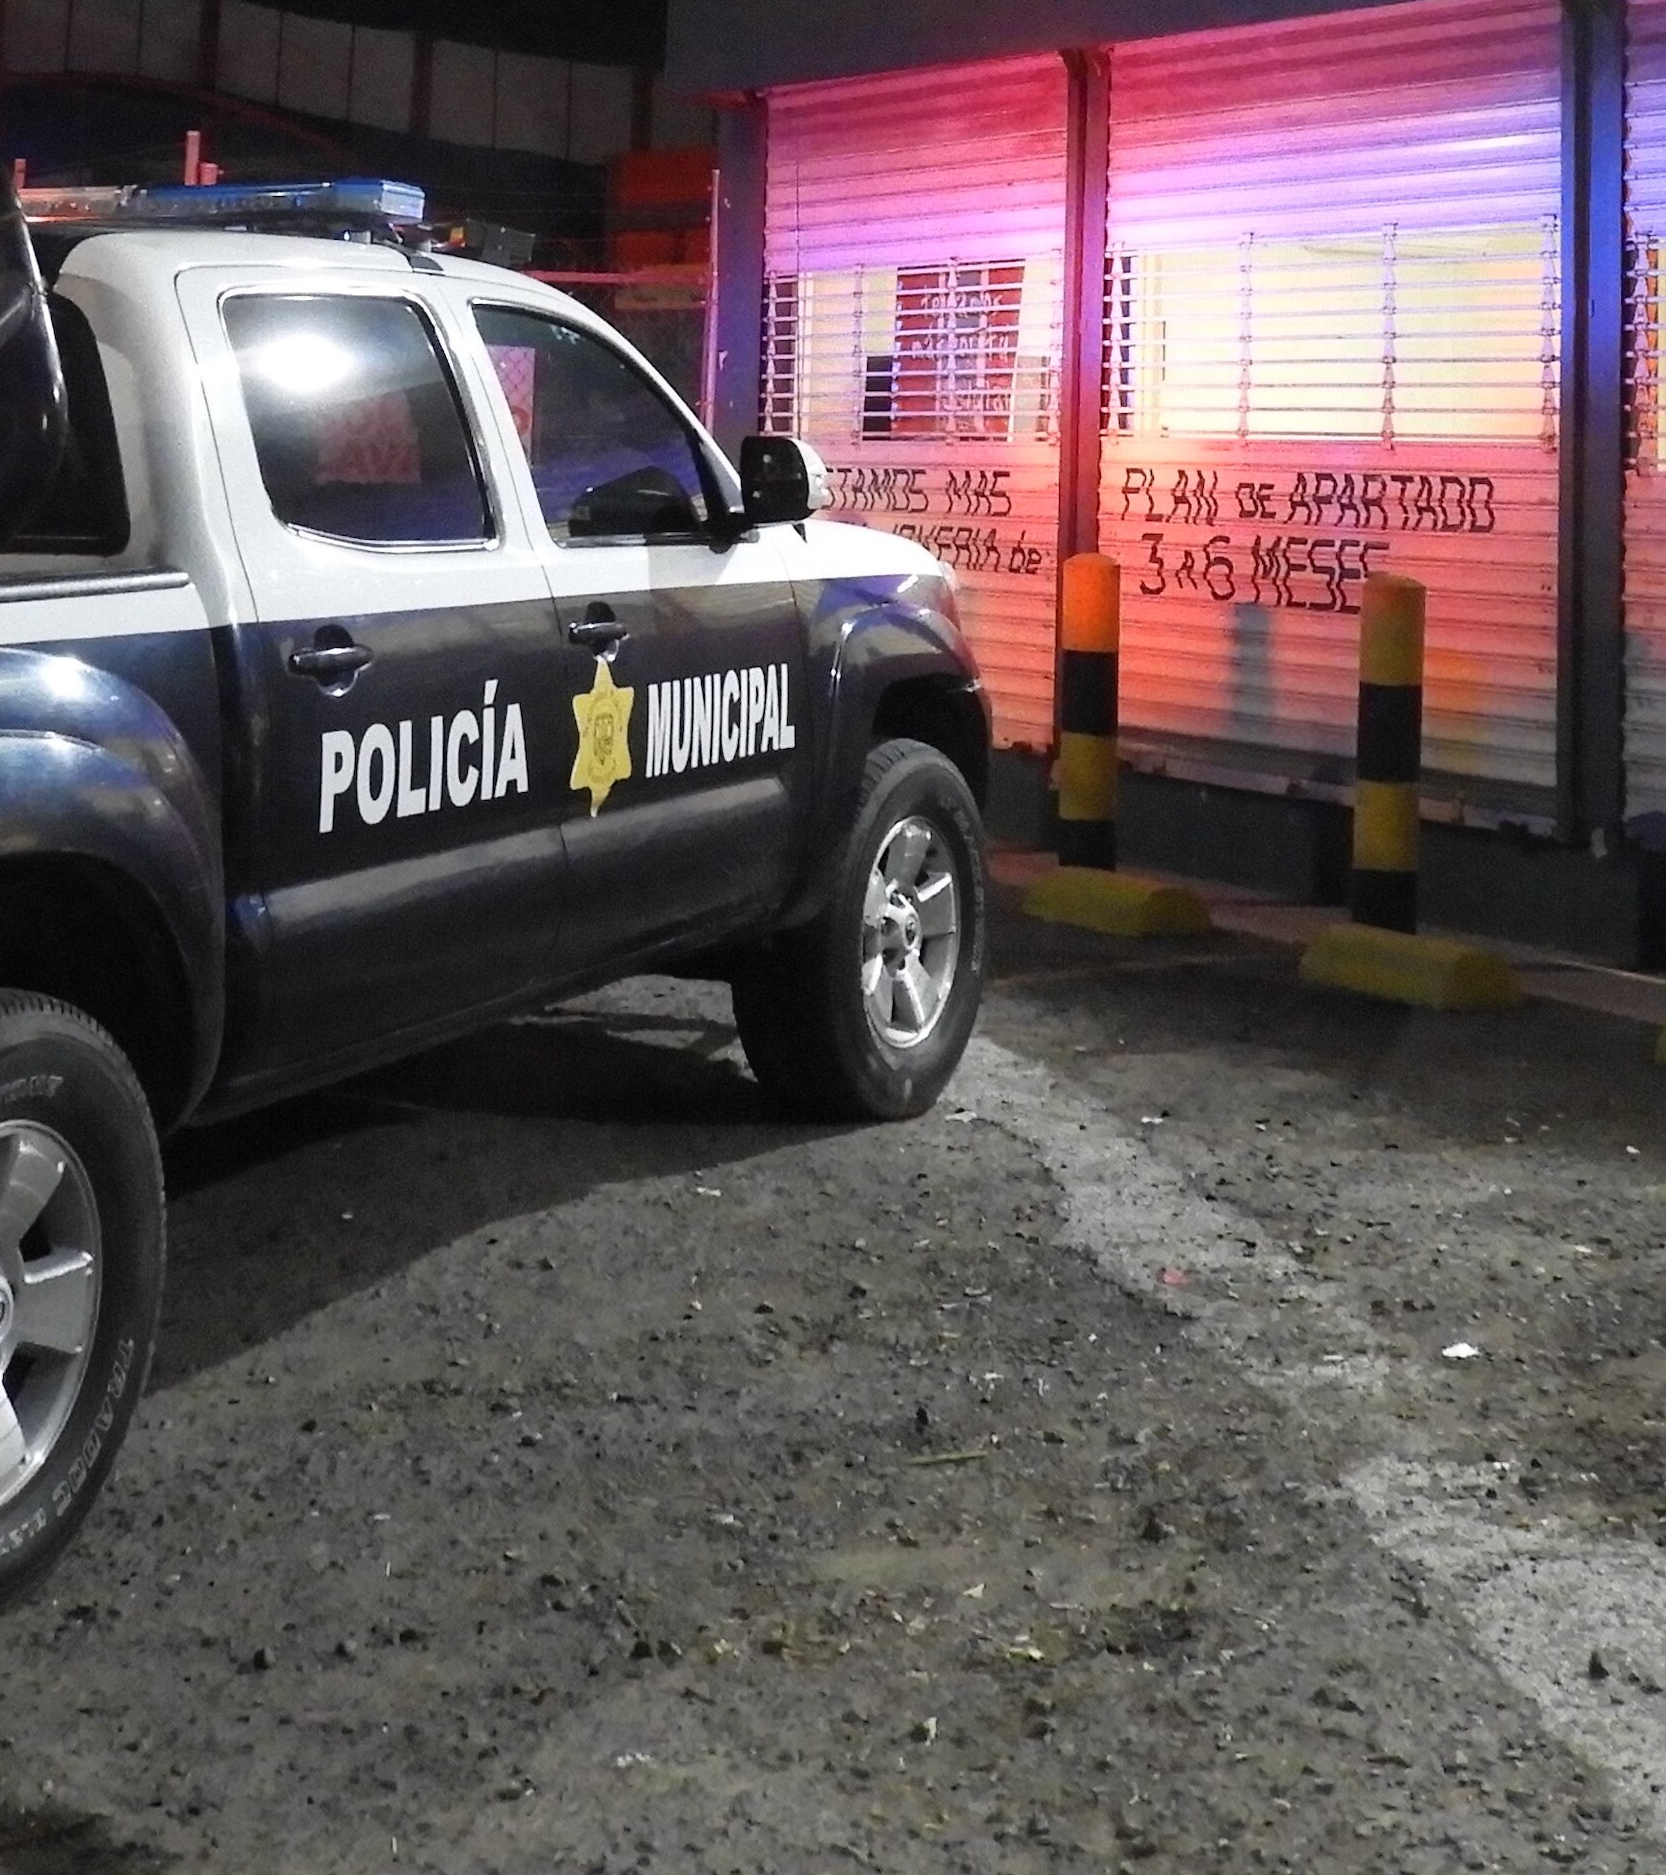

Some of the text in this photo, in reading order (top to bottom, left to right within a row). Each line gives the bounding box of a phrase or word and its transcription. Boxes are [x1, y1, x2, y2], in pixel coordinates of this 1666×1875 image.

[946, 469, 1012, 517] MAS
[1121, 467, 1219, 526] PLAN
[1284, 472, 1496, 533] APARTADO
[893, 524, 1002, 573] YERIA
[1139, 532, 1166, 595] 3
[1203, 534, 1236, 602] 6
[319, 663, 796, 834] POLICÍA MUNICIPAL
